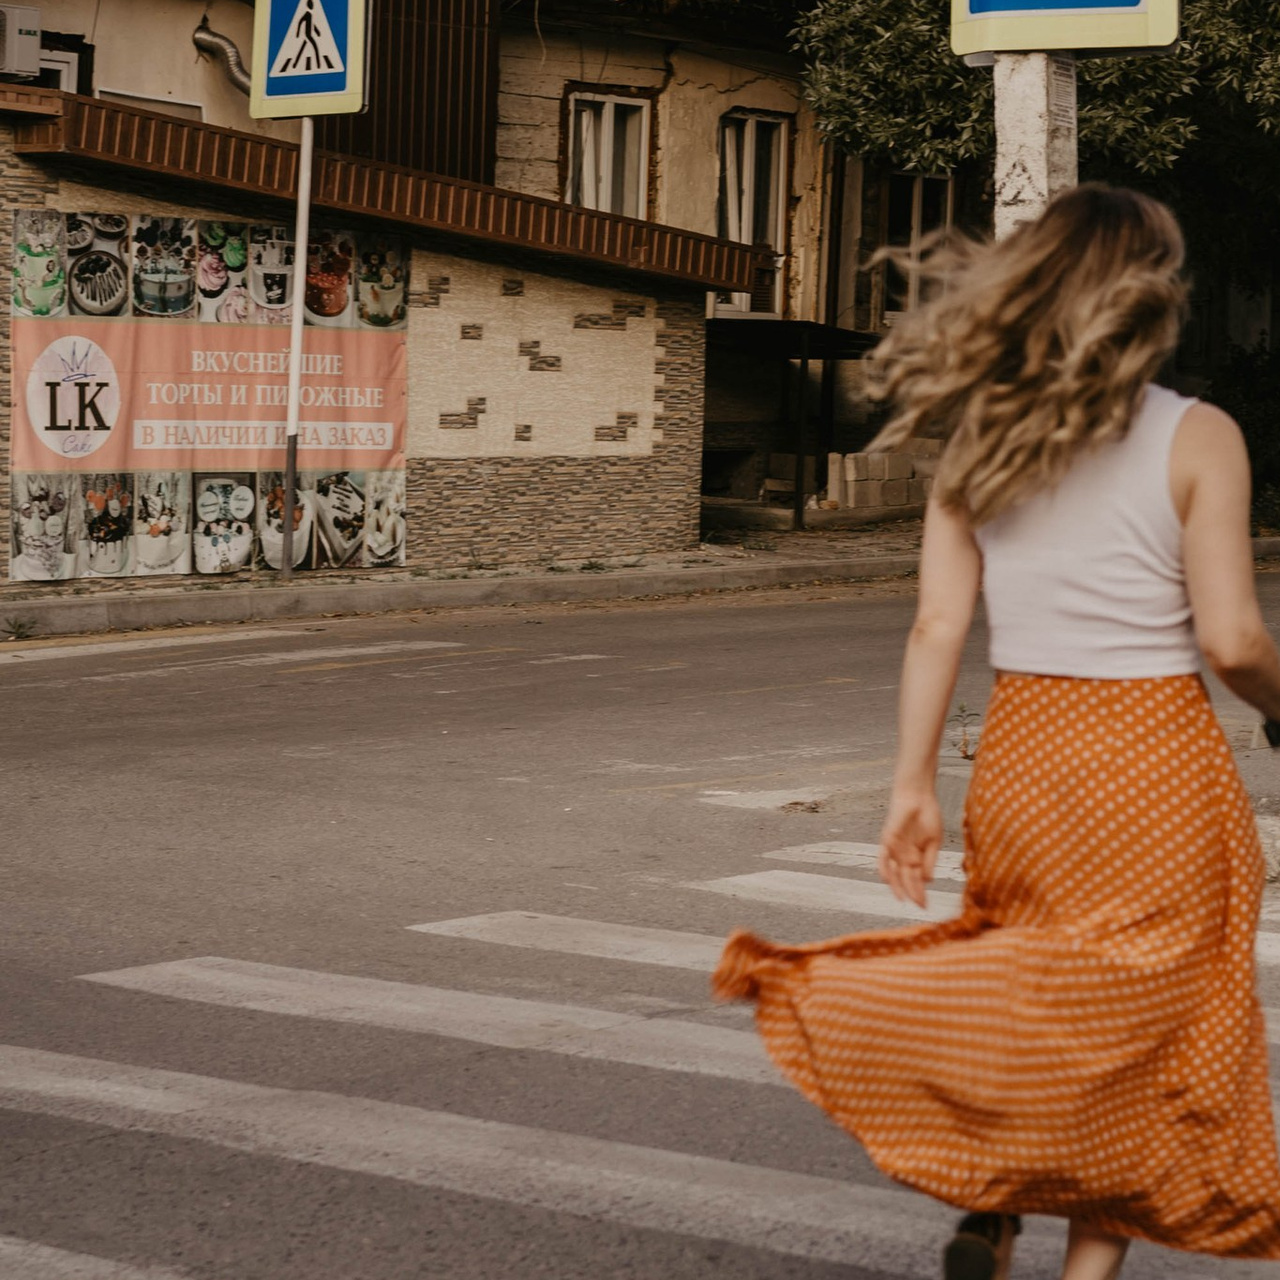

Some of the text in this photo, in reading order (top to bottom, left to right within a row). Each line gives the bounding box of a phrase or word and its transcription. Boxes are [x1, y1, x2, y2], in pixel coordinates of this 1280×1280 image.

[191, 347, 343, 375] ВКУСНЕЙШИЕ
[45, 382, 111, 431] LK
[146, 383, 384, 408] ТОРТЫ И ПИОЖНЫЕ
[141, 426, 155, 445] В
[164, 426, 267, 445] НАЛИЧИИ
[328, 427, 387, 446] ЗАКАЗ
